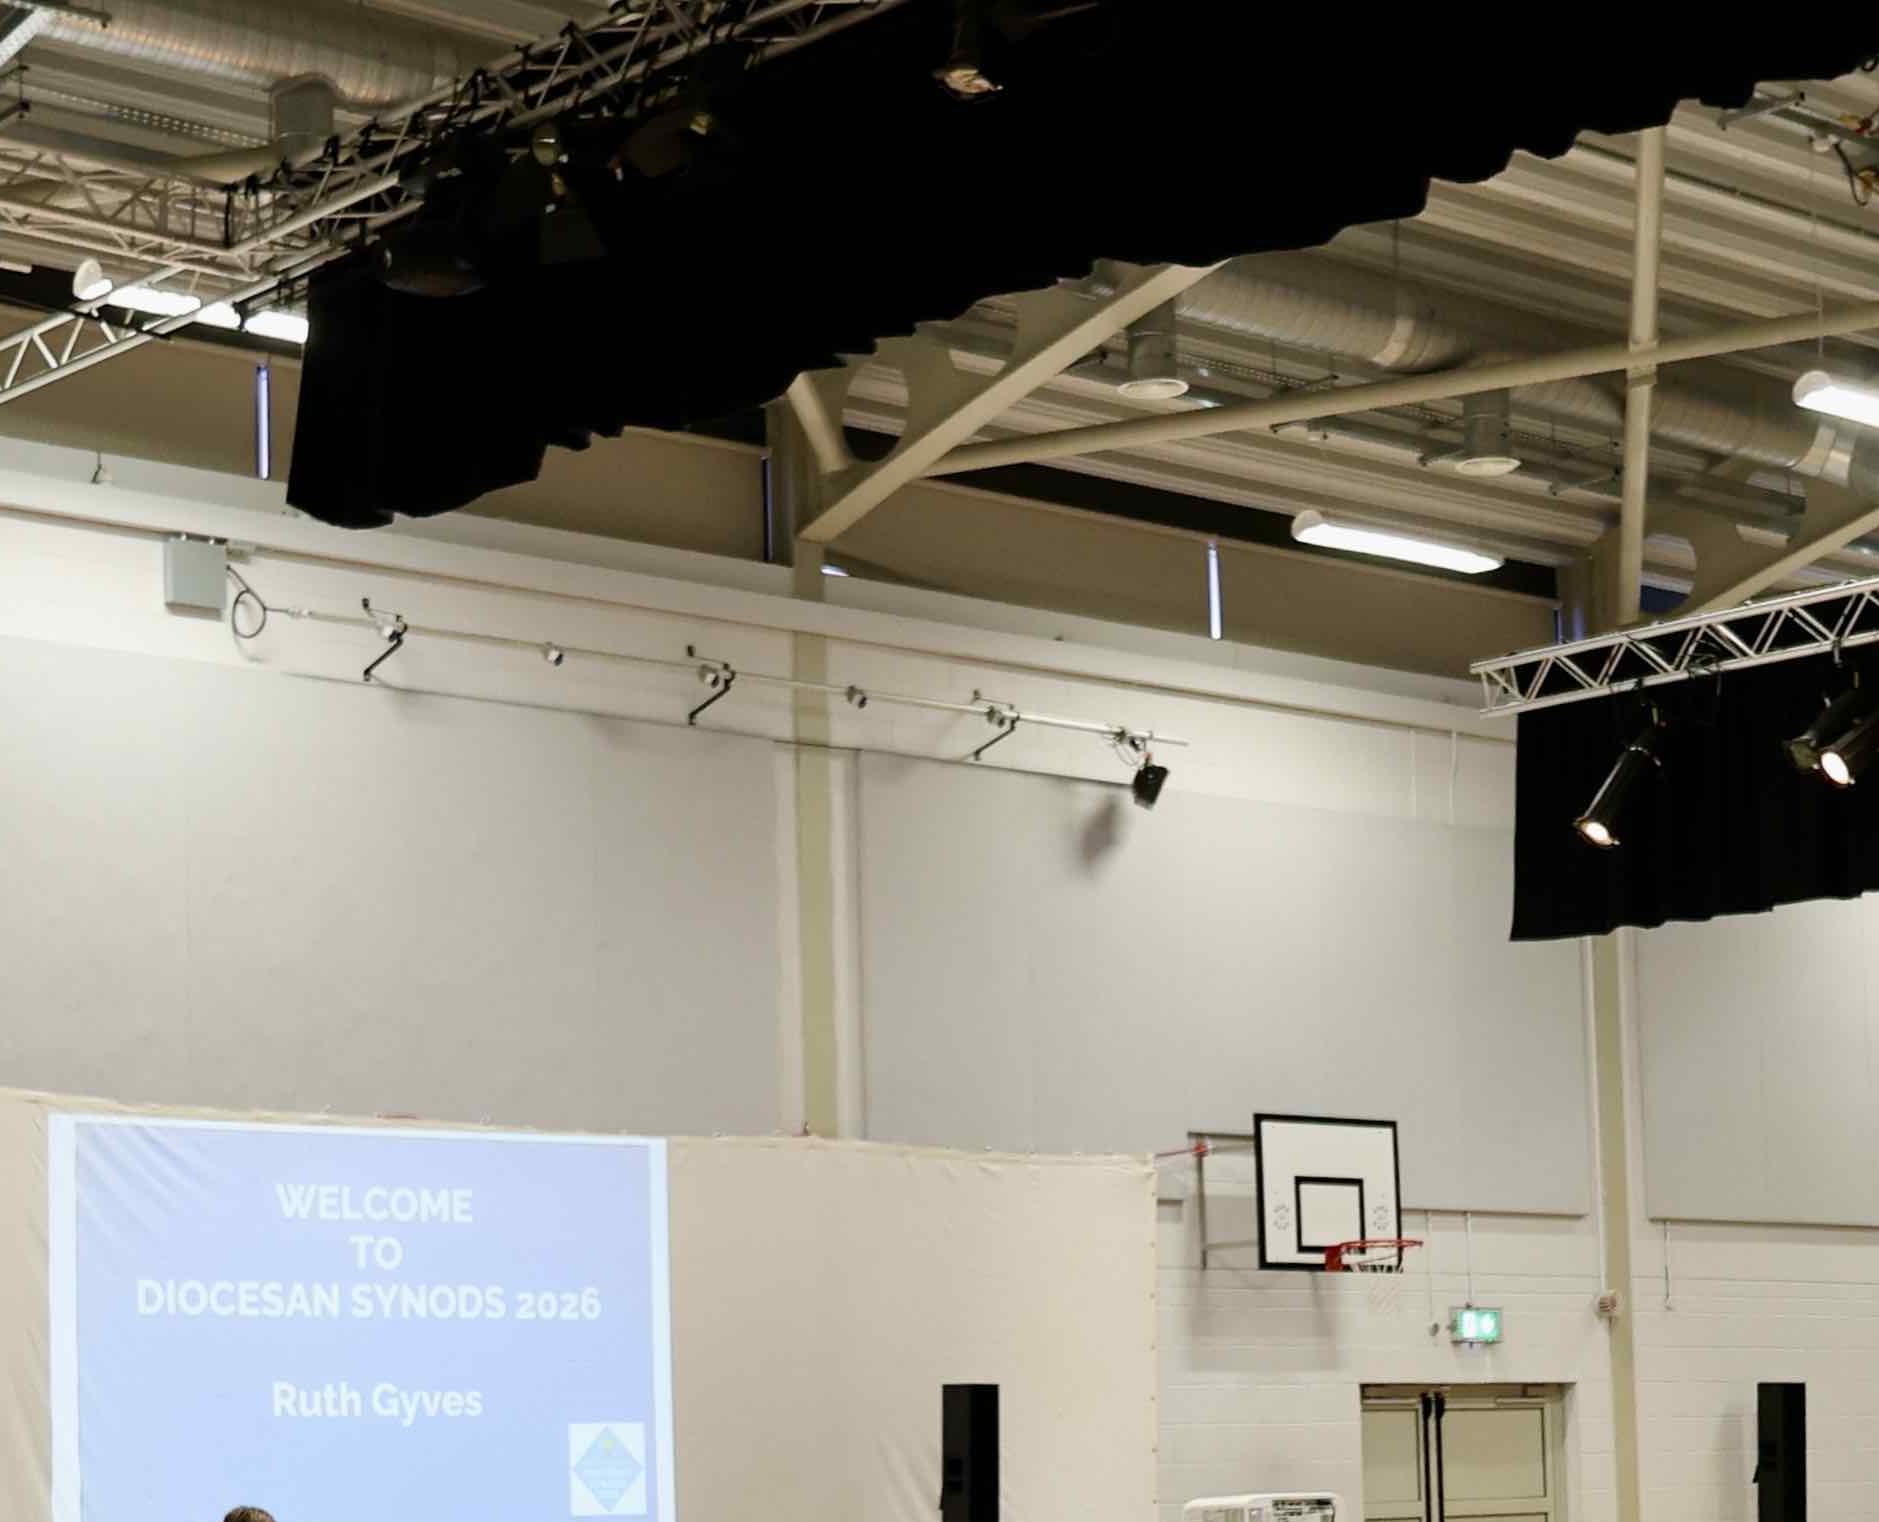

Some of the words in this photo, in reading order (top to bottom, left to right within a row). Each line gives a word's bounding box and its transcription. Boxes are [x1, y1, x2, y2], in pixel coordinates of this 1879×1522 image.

[276, 1183, 474, 1223] WELCOME
[349, 1235, 403, 1271] TO
[136, 1278, 339, 1319] DIOCESAN
[351, 1283, 506, 1320] SYNODS
[516, 1288, 601, 1321] 2026
[272, 1381, 362, 1417] Ruth
[372, 1385, 483, 1426] Gyves
